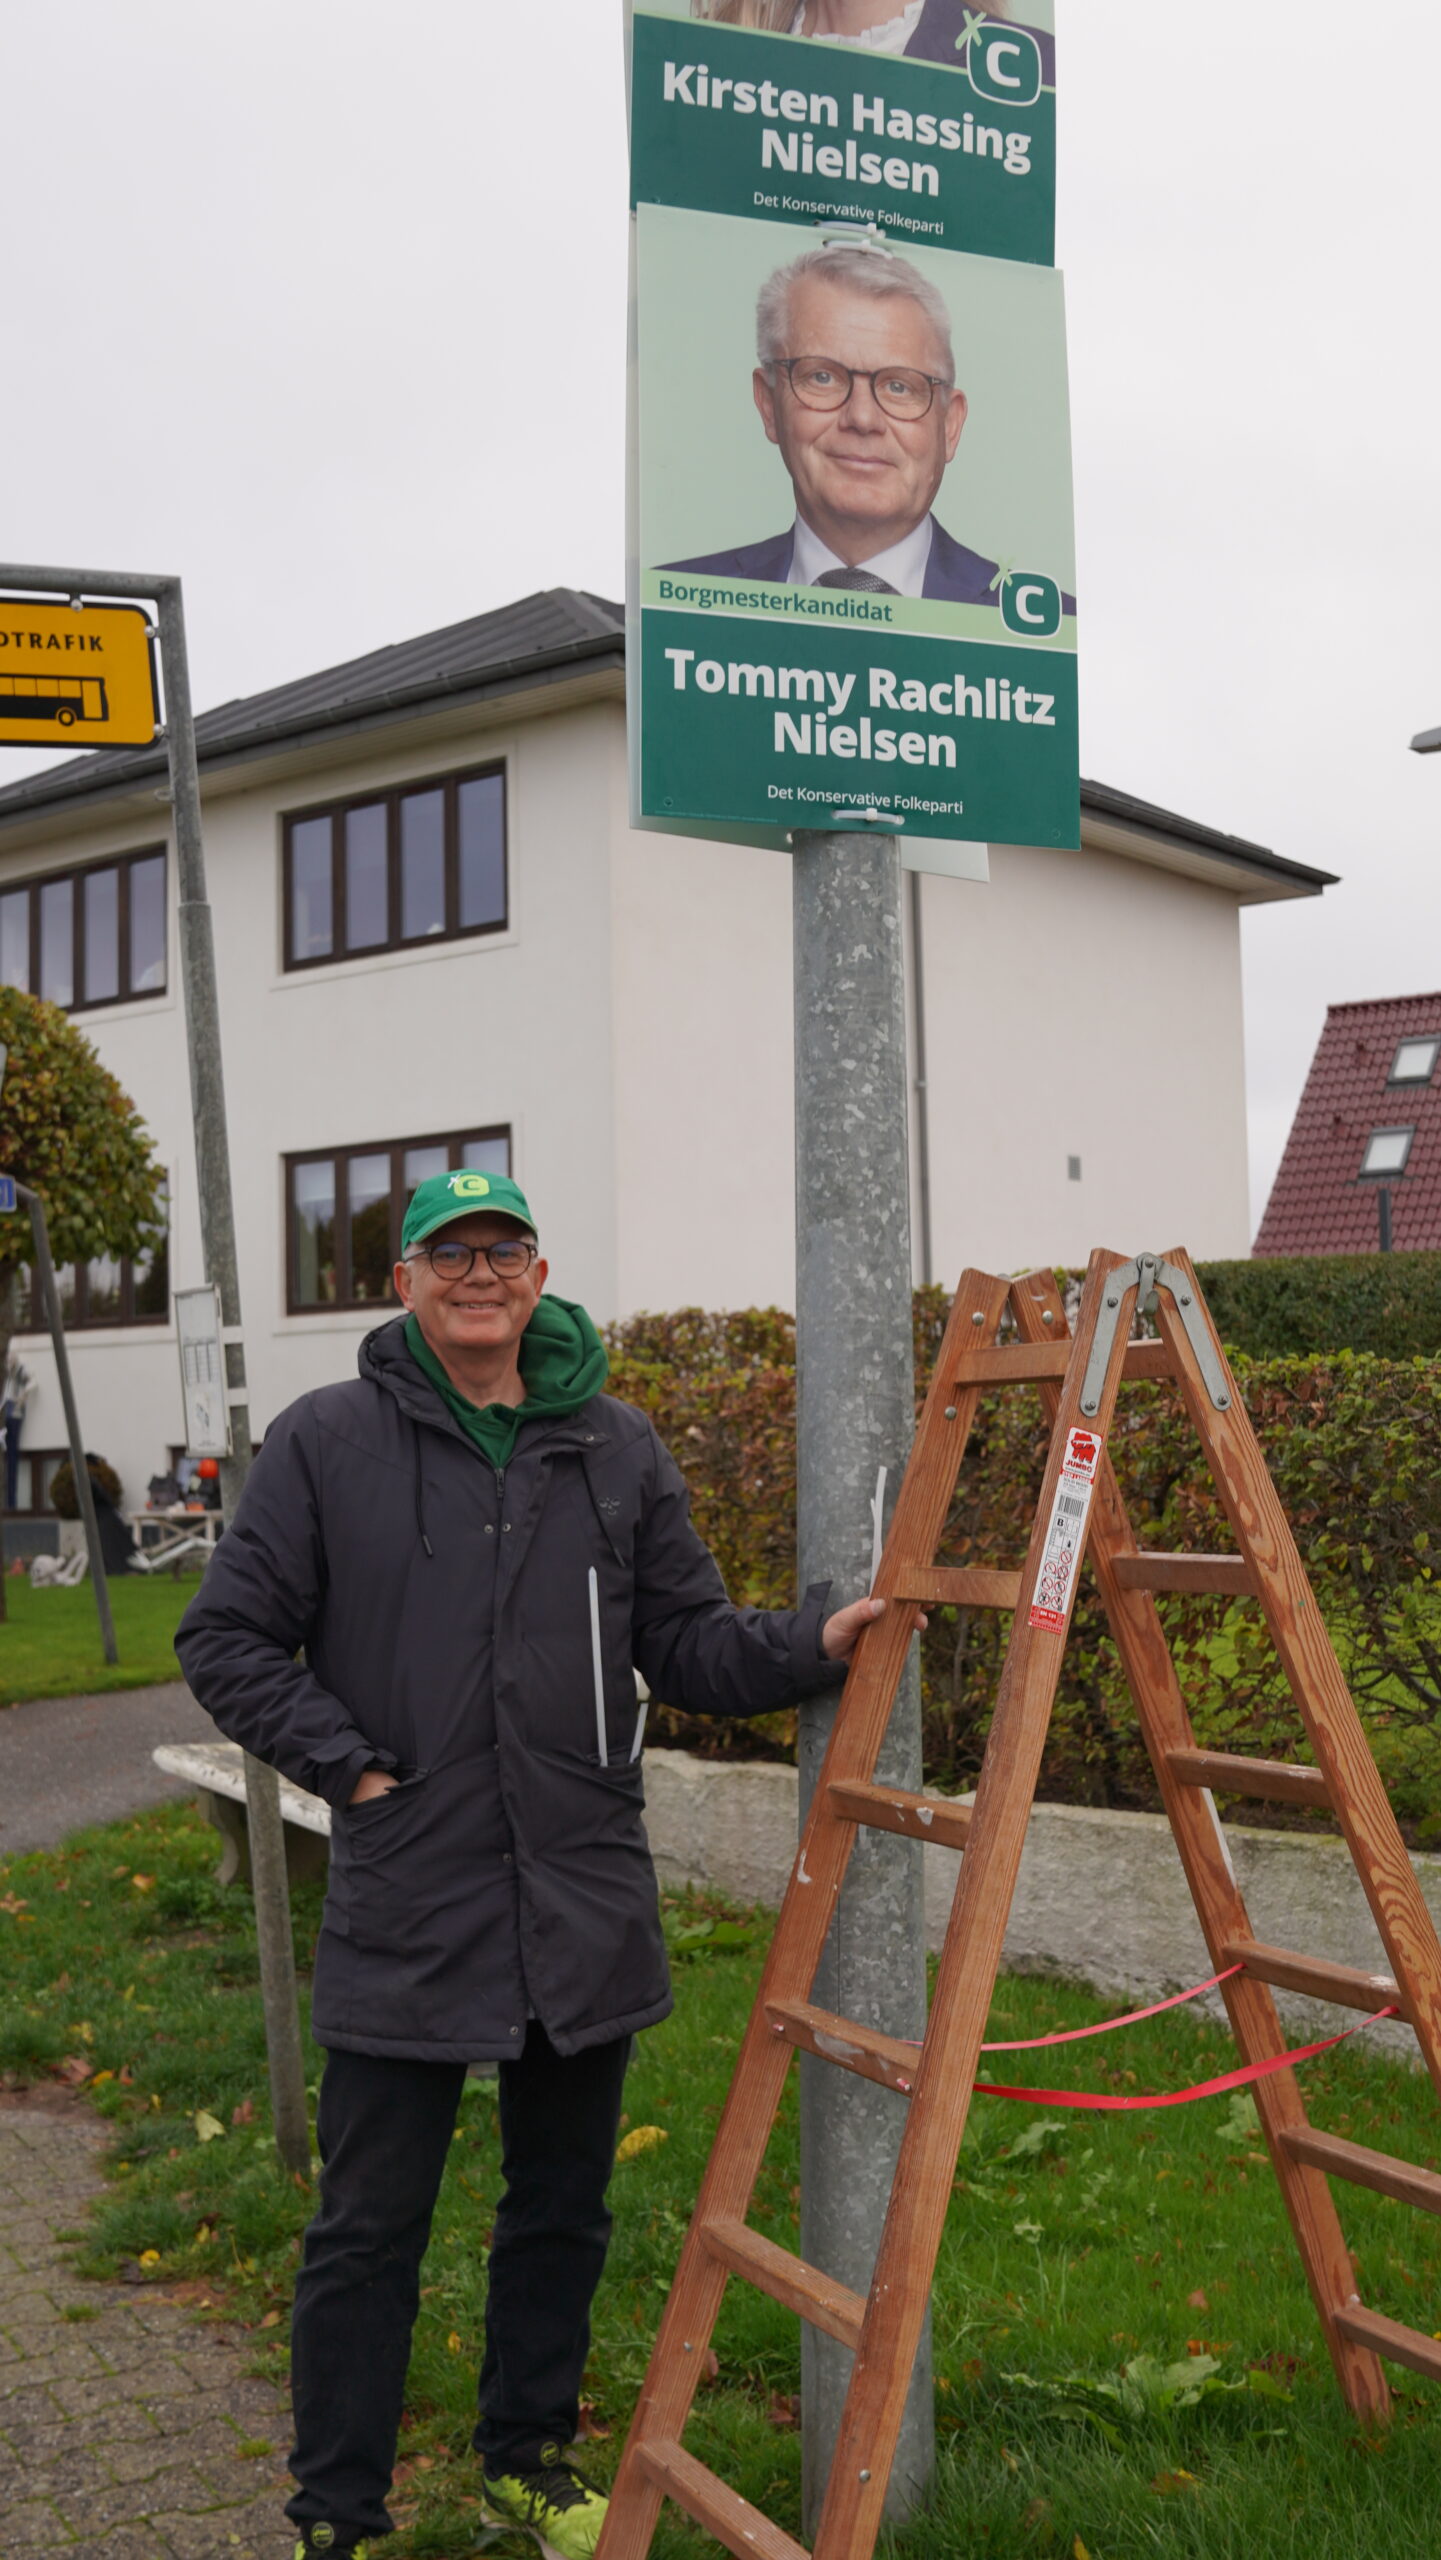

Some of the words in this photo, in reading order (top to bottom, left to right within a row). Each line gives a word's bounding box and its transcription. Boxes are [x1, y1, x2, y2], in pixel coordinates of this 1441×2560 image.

[985, 40, 1021, 88] C
[663, 61, 839, 127] Kirsten
[852, 93, 1032, 175] Hassing
[761, 128, 939, 197] Nielsen
[753, 191, 779, 209] Det
[782, 196, 875, 221] Konservative
[877, 209, 944, 236] Folkeparti
[659, 580, 893, 622] Borgmesterkandidat
[1014, 584, 1046, 624] C
[664, 647, 857, 716] Tommy
[869, 667, 1056, 726] Rachlitz
[773, 711, 957, 768] Nielsen
[767, 784, 793, 801] Det
[797, 786, 891, 808] Konservative
[893, 795, 964, 815] Folkeparti
[462, 1178, 481, 1191] C
[1065, 1459, 1093, 1473] JUMBO
[1056, 1518, 1064, 1527] B
